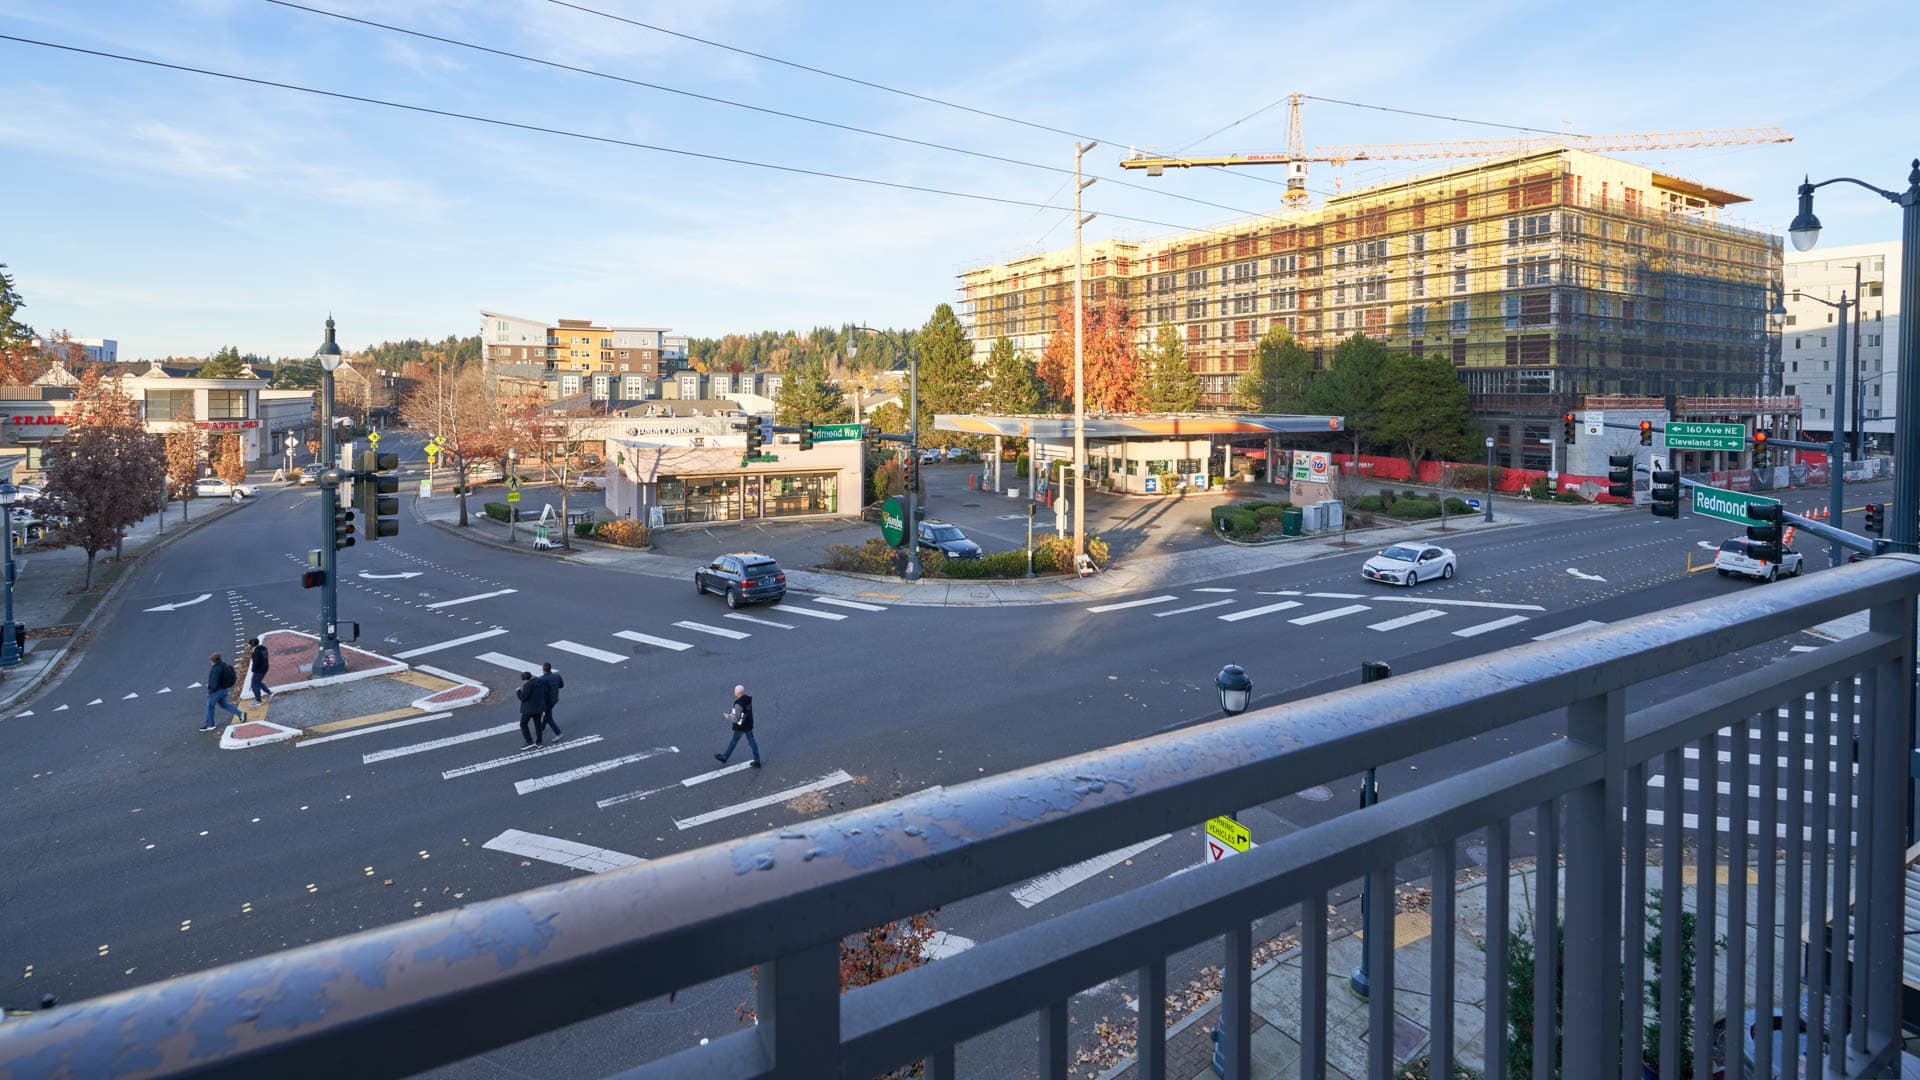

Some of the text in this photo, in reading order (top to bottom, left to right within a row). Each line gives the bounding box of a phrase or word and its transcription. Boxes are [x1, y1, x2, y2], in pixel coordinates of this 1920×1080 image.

[813, 427, 860, 439] edmond Way
[1686, 425, 1738, 435] 160 Ave NE
[1669, 438, 1723, 447] Cleveland St
[1696, 491, 1747, 517] Redmond
[1208, 823, 1236, 845] VEHICLES
